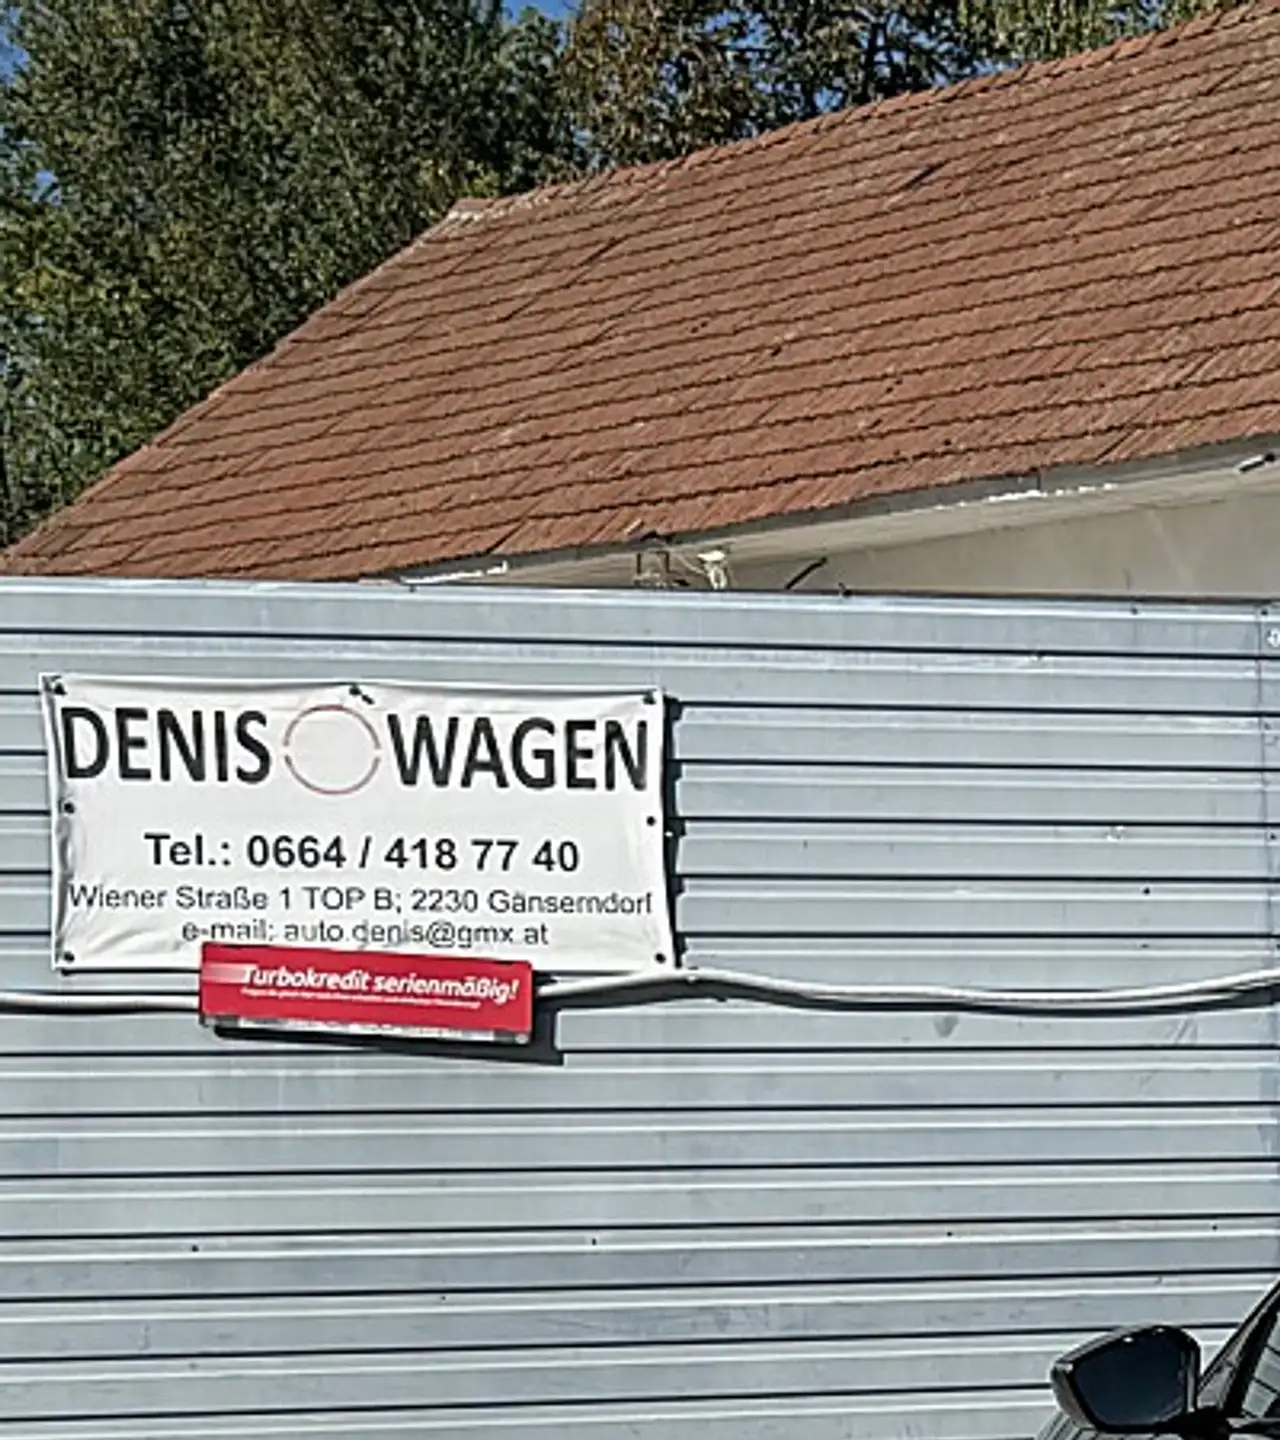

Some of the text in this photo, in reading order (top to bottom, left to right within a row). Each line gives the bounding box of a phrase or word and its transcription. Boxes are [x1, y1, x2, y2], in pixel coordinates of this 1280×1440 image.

[60, 707, 648, 791] DENIS WAGEN
[144, 832, 580, 873] Tel.: 0664 / 418 77 40
[69, 884, 168, 909] Wiener
[175, 884, 268, 911] Straße
[280, 886, 290, 911] 1
[301, 885, 366, 911] TOP
[411, 888, 478, 913] 2230
[486, 889, 652, 915] Gänserndorf
[244, 965, 371, 991] Turbokredit
[371, 972, 520, 1005] serienmäßig!
